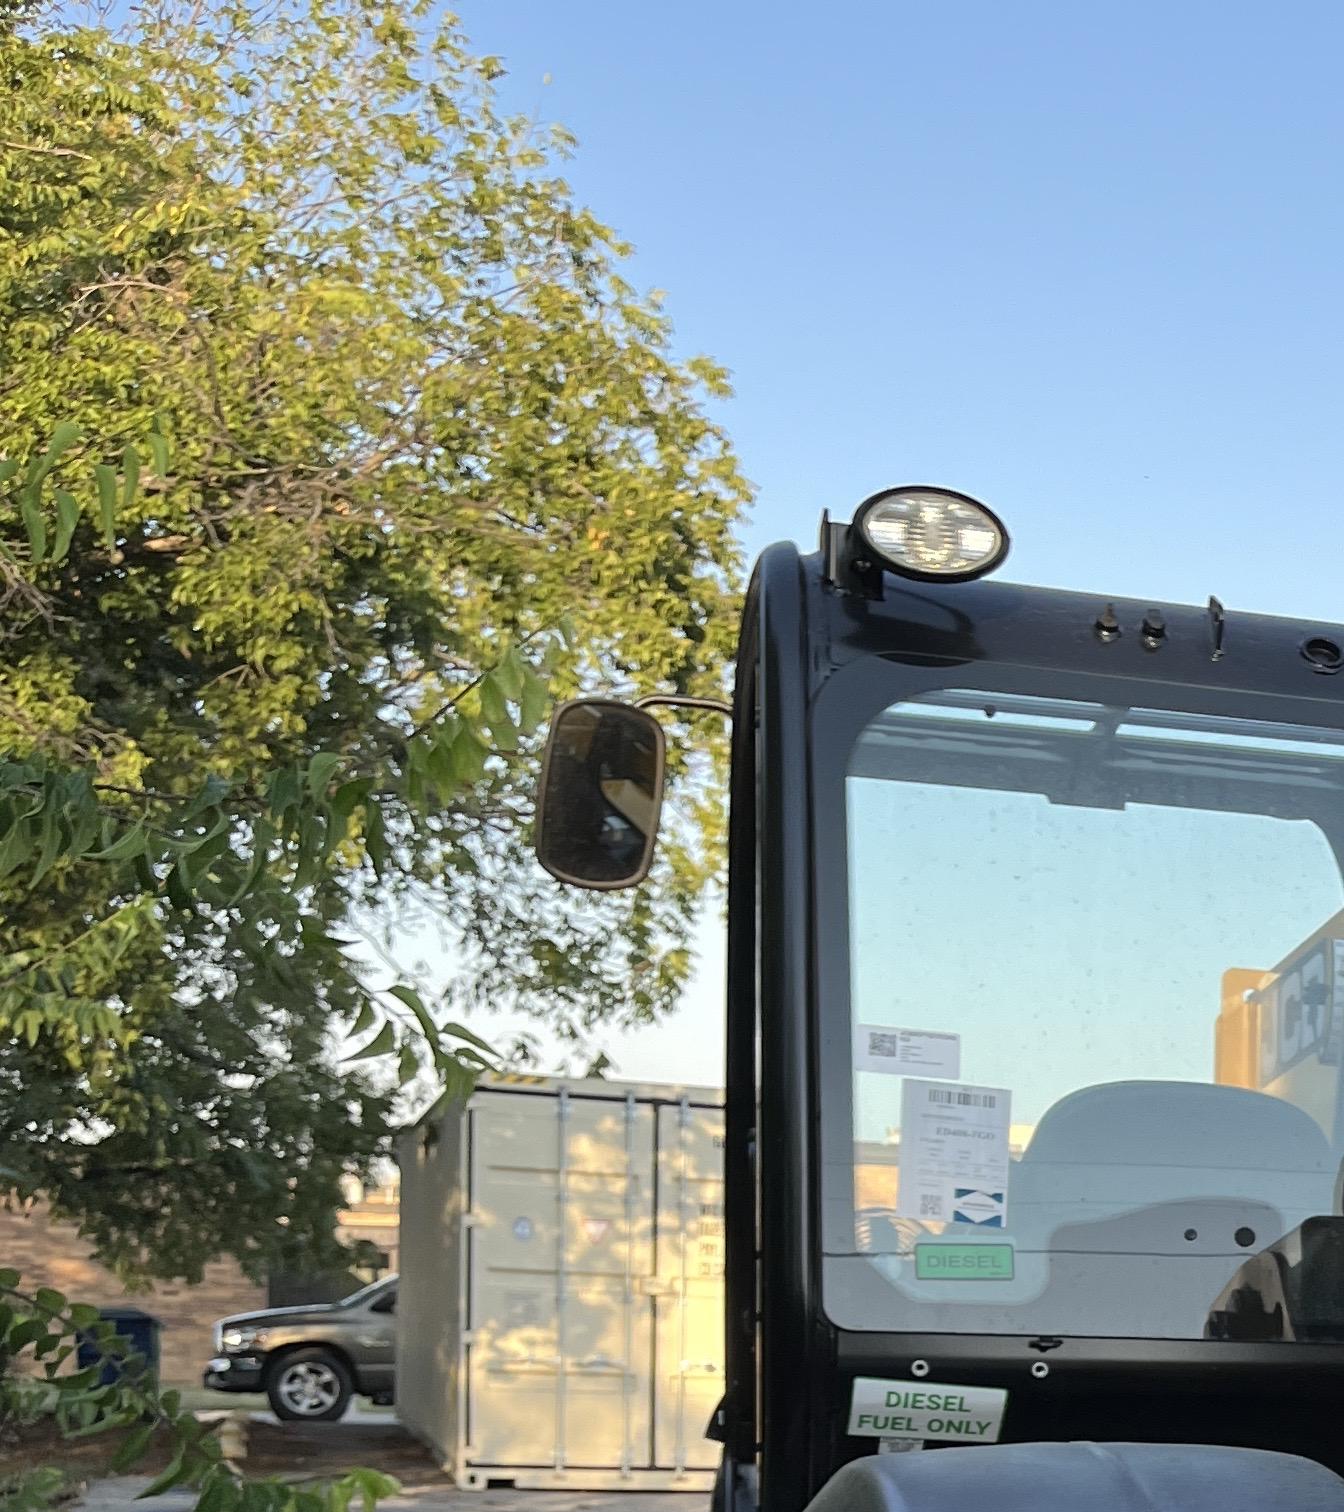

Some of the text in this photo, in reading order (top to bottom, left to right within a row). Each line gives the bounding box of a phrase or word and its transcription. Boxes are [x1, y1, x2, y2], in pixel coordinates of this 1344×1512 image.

[926, 1254, 1003, 1269] DIESEL
[885, 1390, 972, 1413] DIESEL
[857, 1414, 992, 1435] FUEL ONLY
